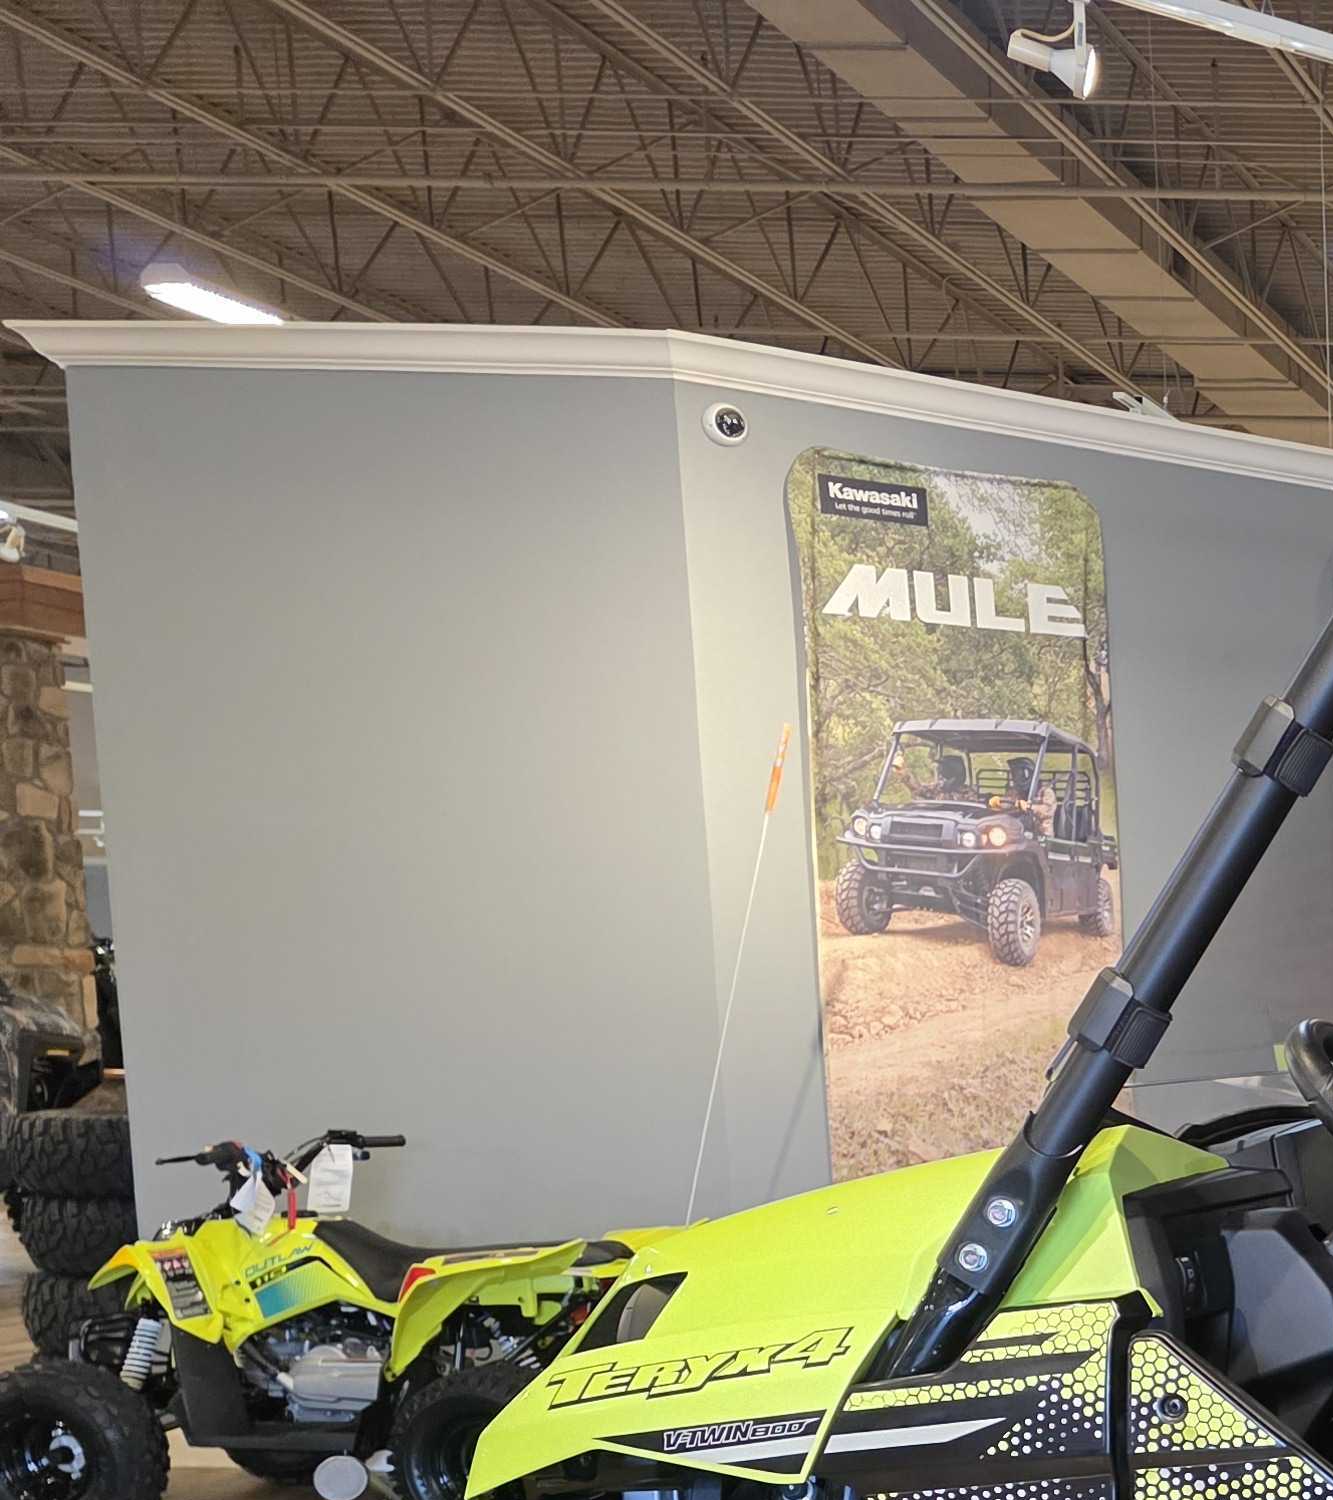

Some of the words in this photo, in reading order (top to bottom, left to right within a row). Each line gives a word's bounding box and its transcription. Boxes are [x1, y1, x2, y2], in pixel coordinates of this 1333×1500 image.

[827, 481, 919, 509] Kawasaki
[822, 563, 1088, 638] MULE
[546, 1326, 855, 1411] TERYX4
